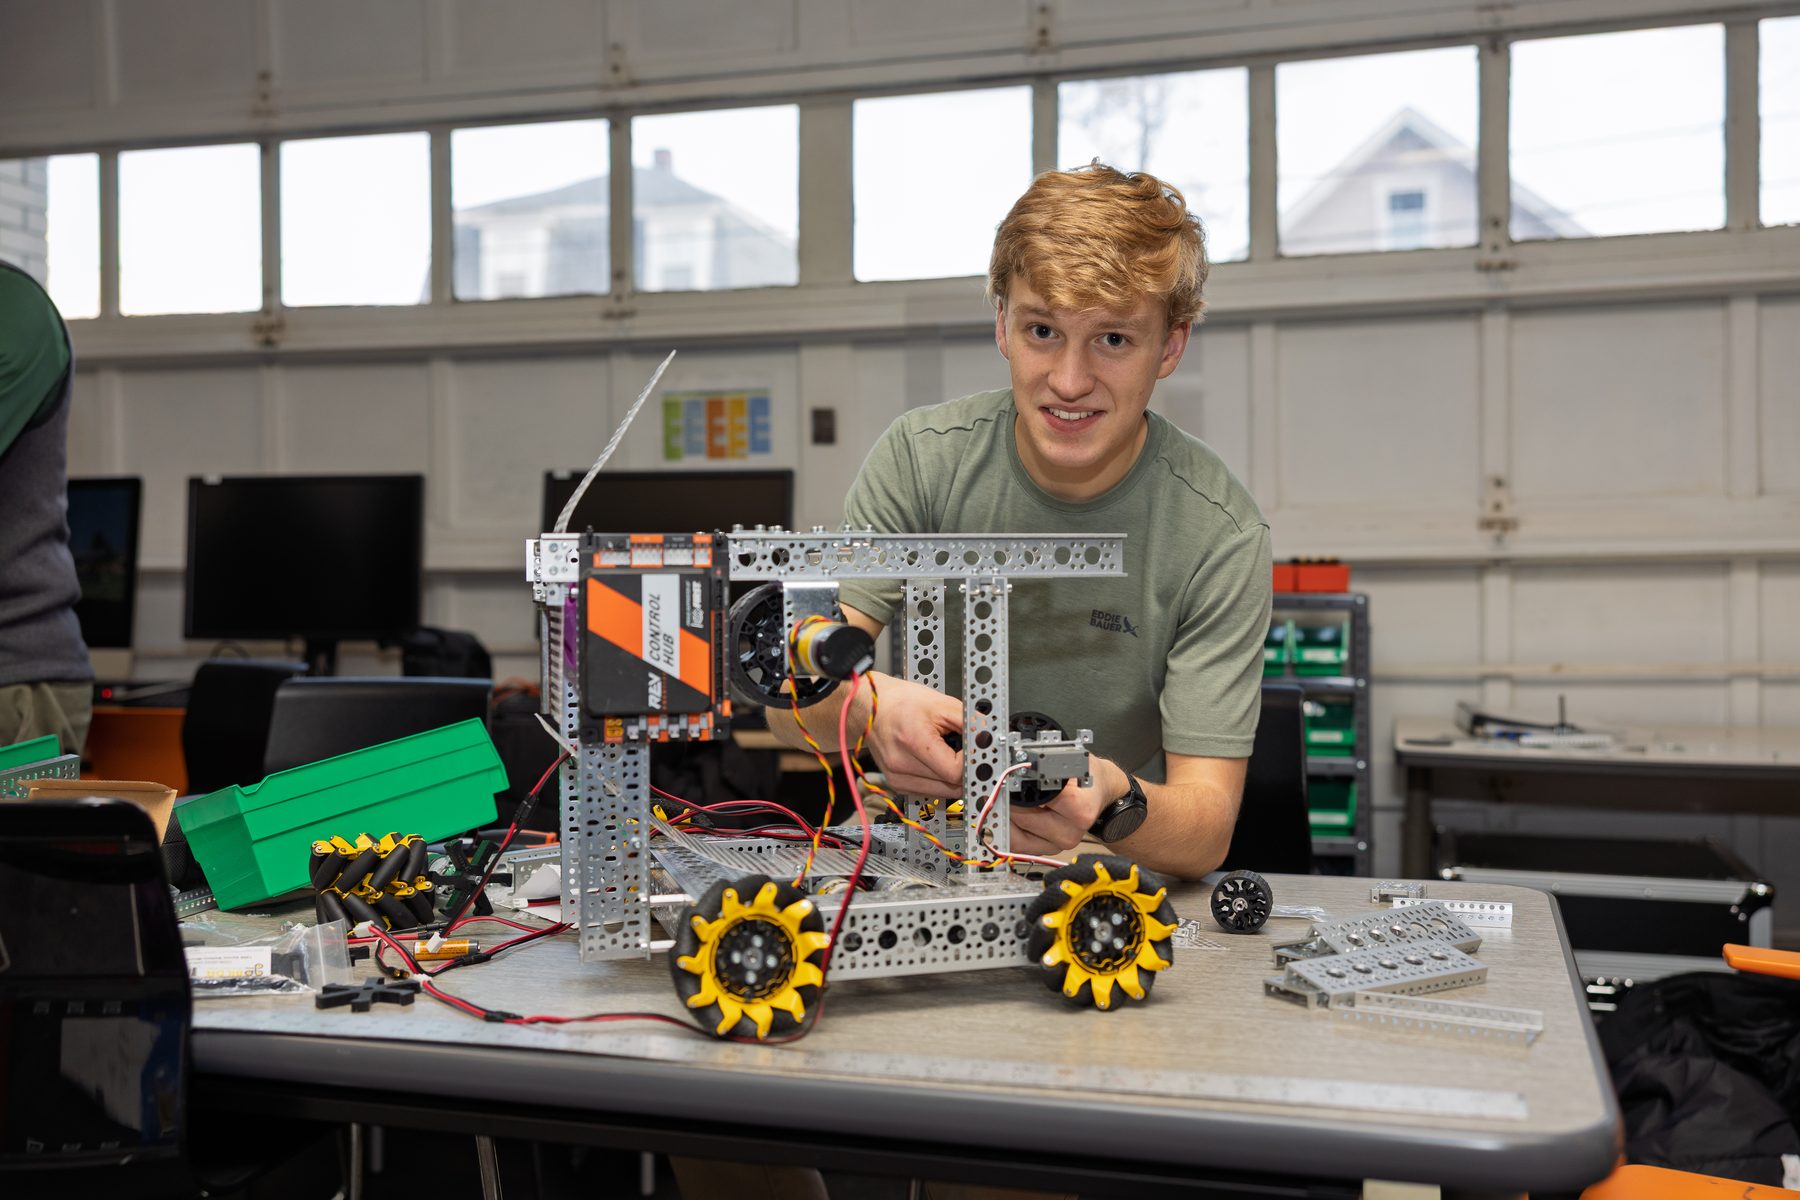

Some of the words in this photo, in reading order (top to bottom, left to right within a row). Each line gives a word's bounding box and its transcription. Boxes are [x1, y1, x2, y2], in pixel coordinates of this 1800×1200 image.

[649, 593, 660, 661] CONTROL
[1090, 618, 1122, 632] BAUER
[1091, 609, 1121, 623] EDDIE
[663, 633, 674, 667] HUB
[648, 672, 662, 710] REV
